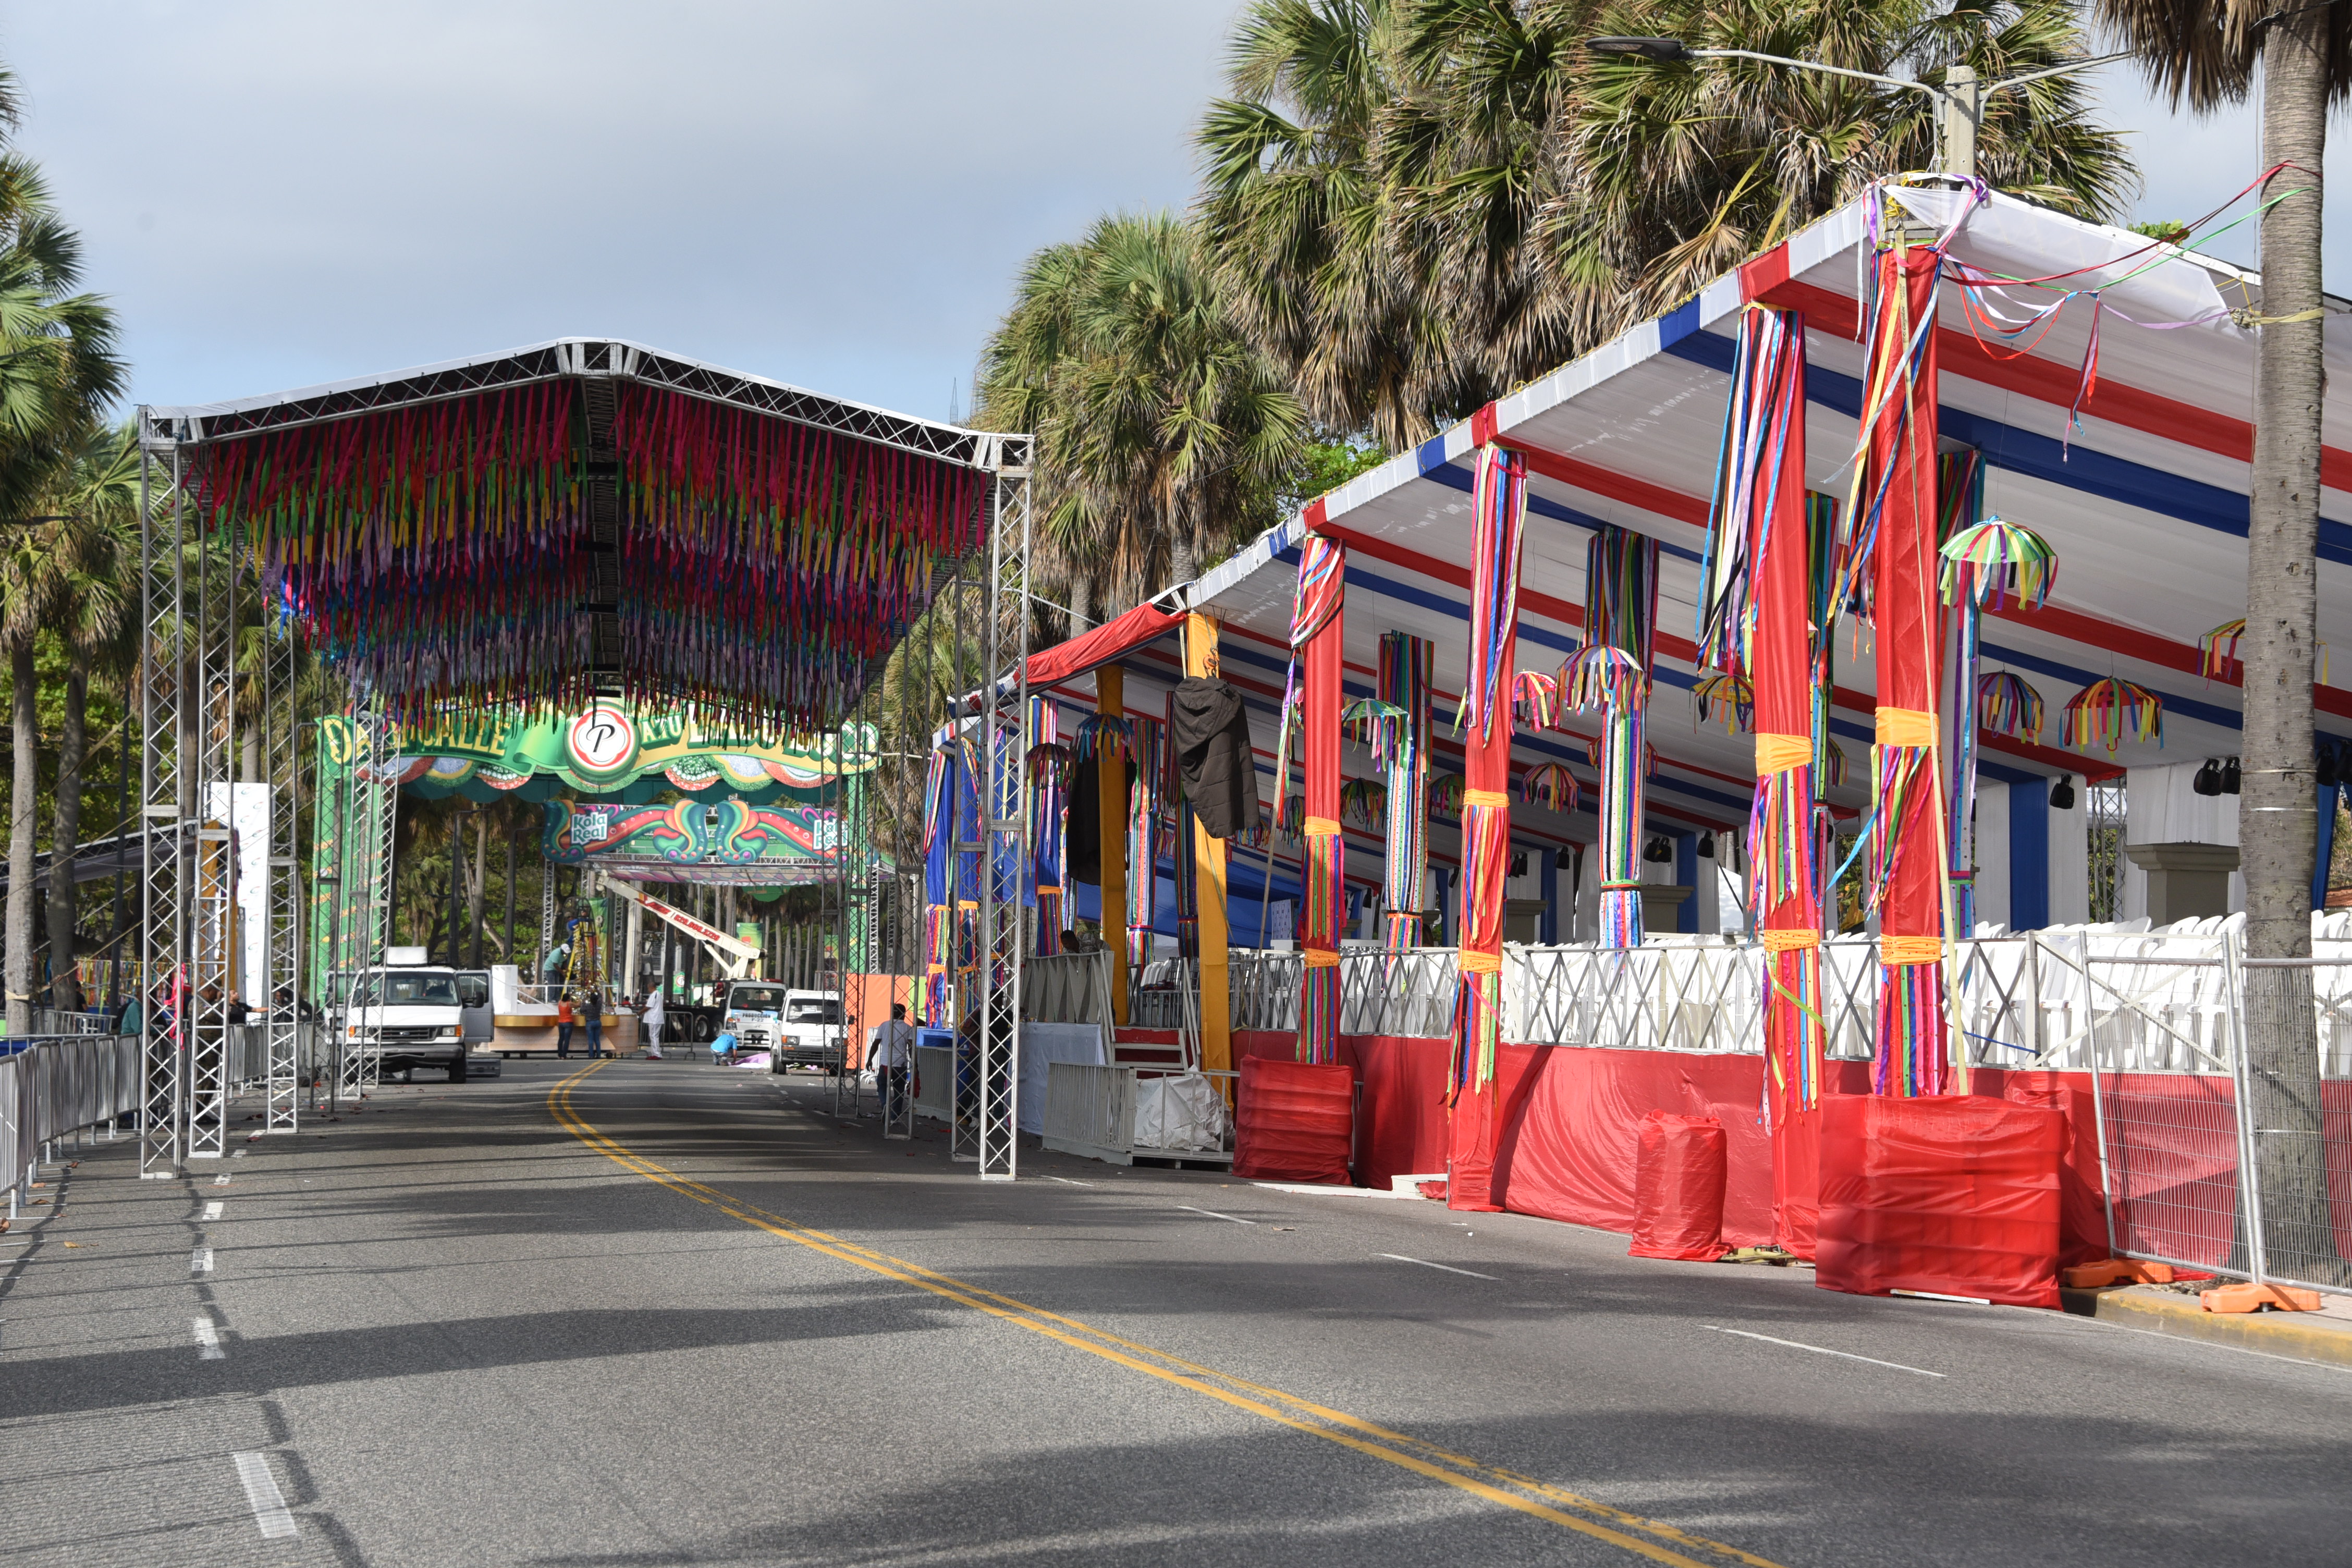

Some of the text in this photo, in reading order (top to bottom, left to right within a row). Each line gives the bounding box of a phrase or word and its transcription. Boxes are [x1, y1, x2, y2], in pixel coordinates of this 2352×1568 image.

[574, 814, 606, 830] Kola
[573, 826, 605, 842] Real
[815, 832, 847, 848] Rel
